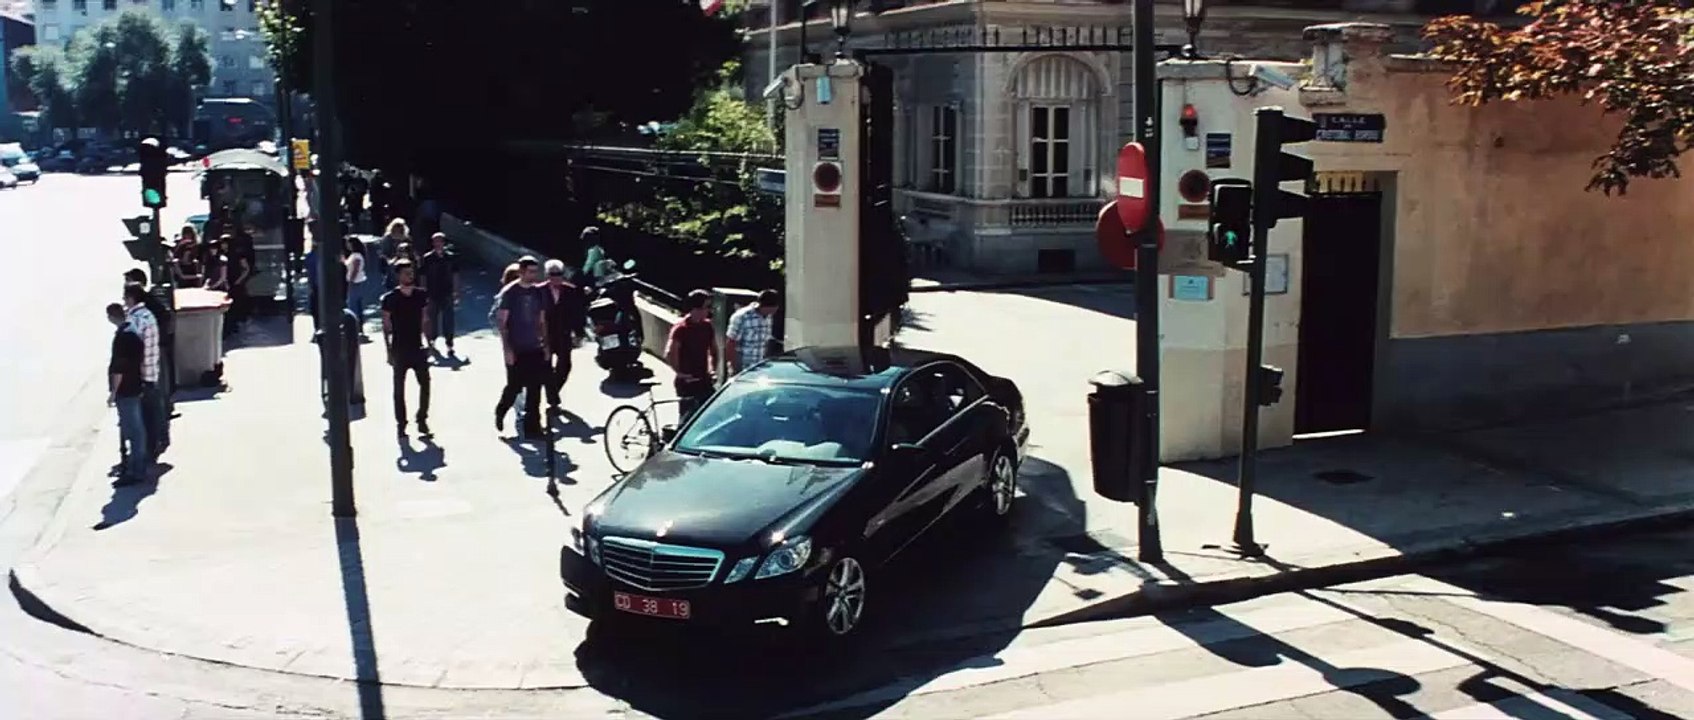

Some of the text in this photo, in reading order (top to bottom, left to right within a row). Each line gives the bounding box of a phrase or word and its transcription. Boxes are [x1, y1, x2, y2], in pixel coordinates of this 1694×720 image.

[615, 594, 688, 616] CD 38 19
